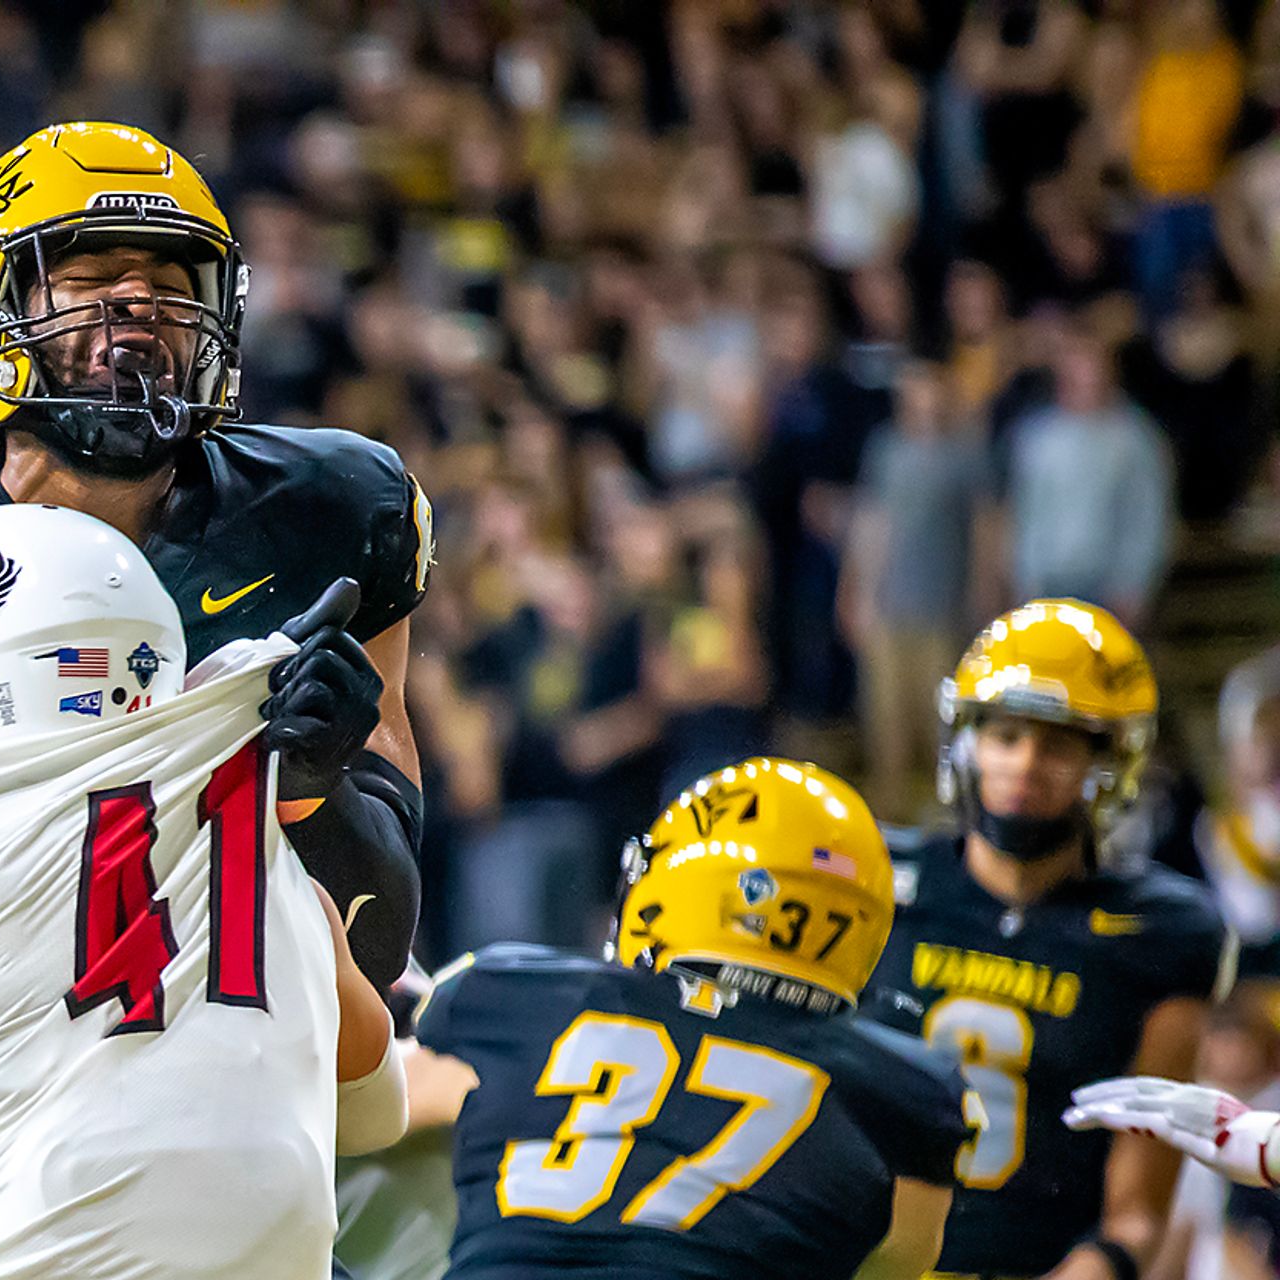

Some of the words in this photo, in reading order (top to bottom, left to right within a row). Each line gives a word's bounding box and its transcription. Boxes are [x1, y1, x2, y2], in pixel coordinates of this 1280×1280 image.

[60, 733, 272, 1040] 41
[770, 899, 854, 962] 37
[495, 1009, 833, 1232] 37
